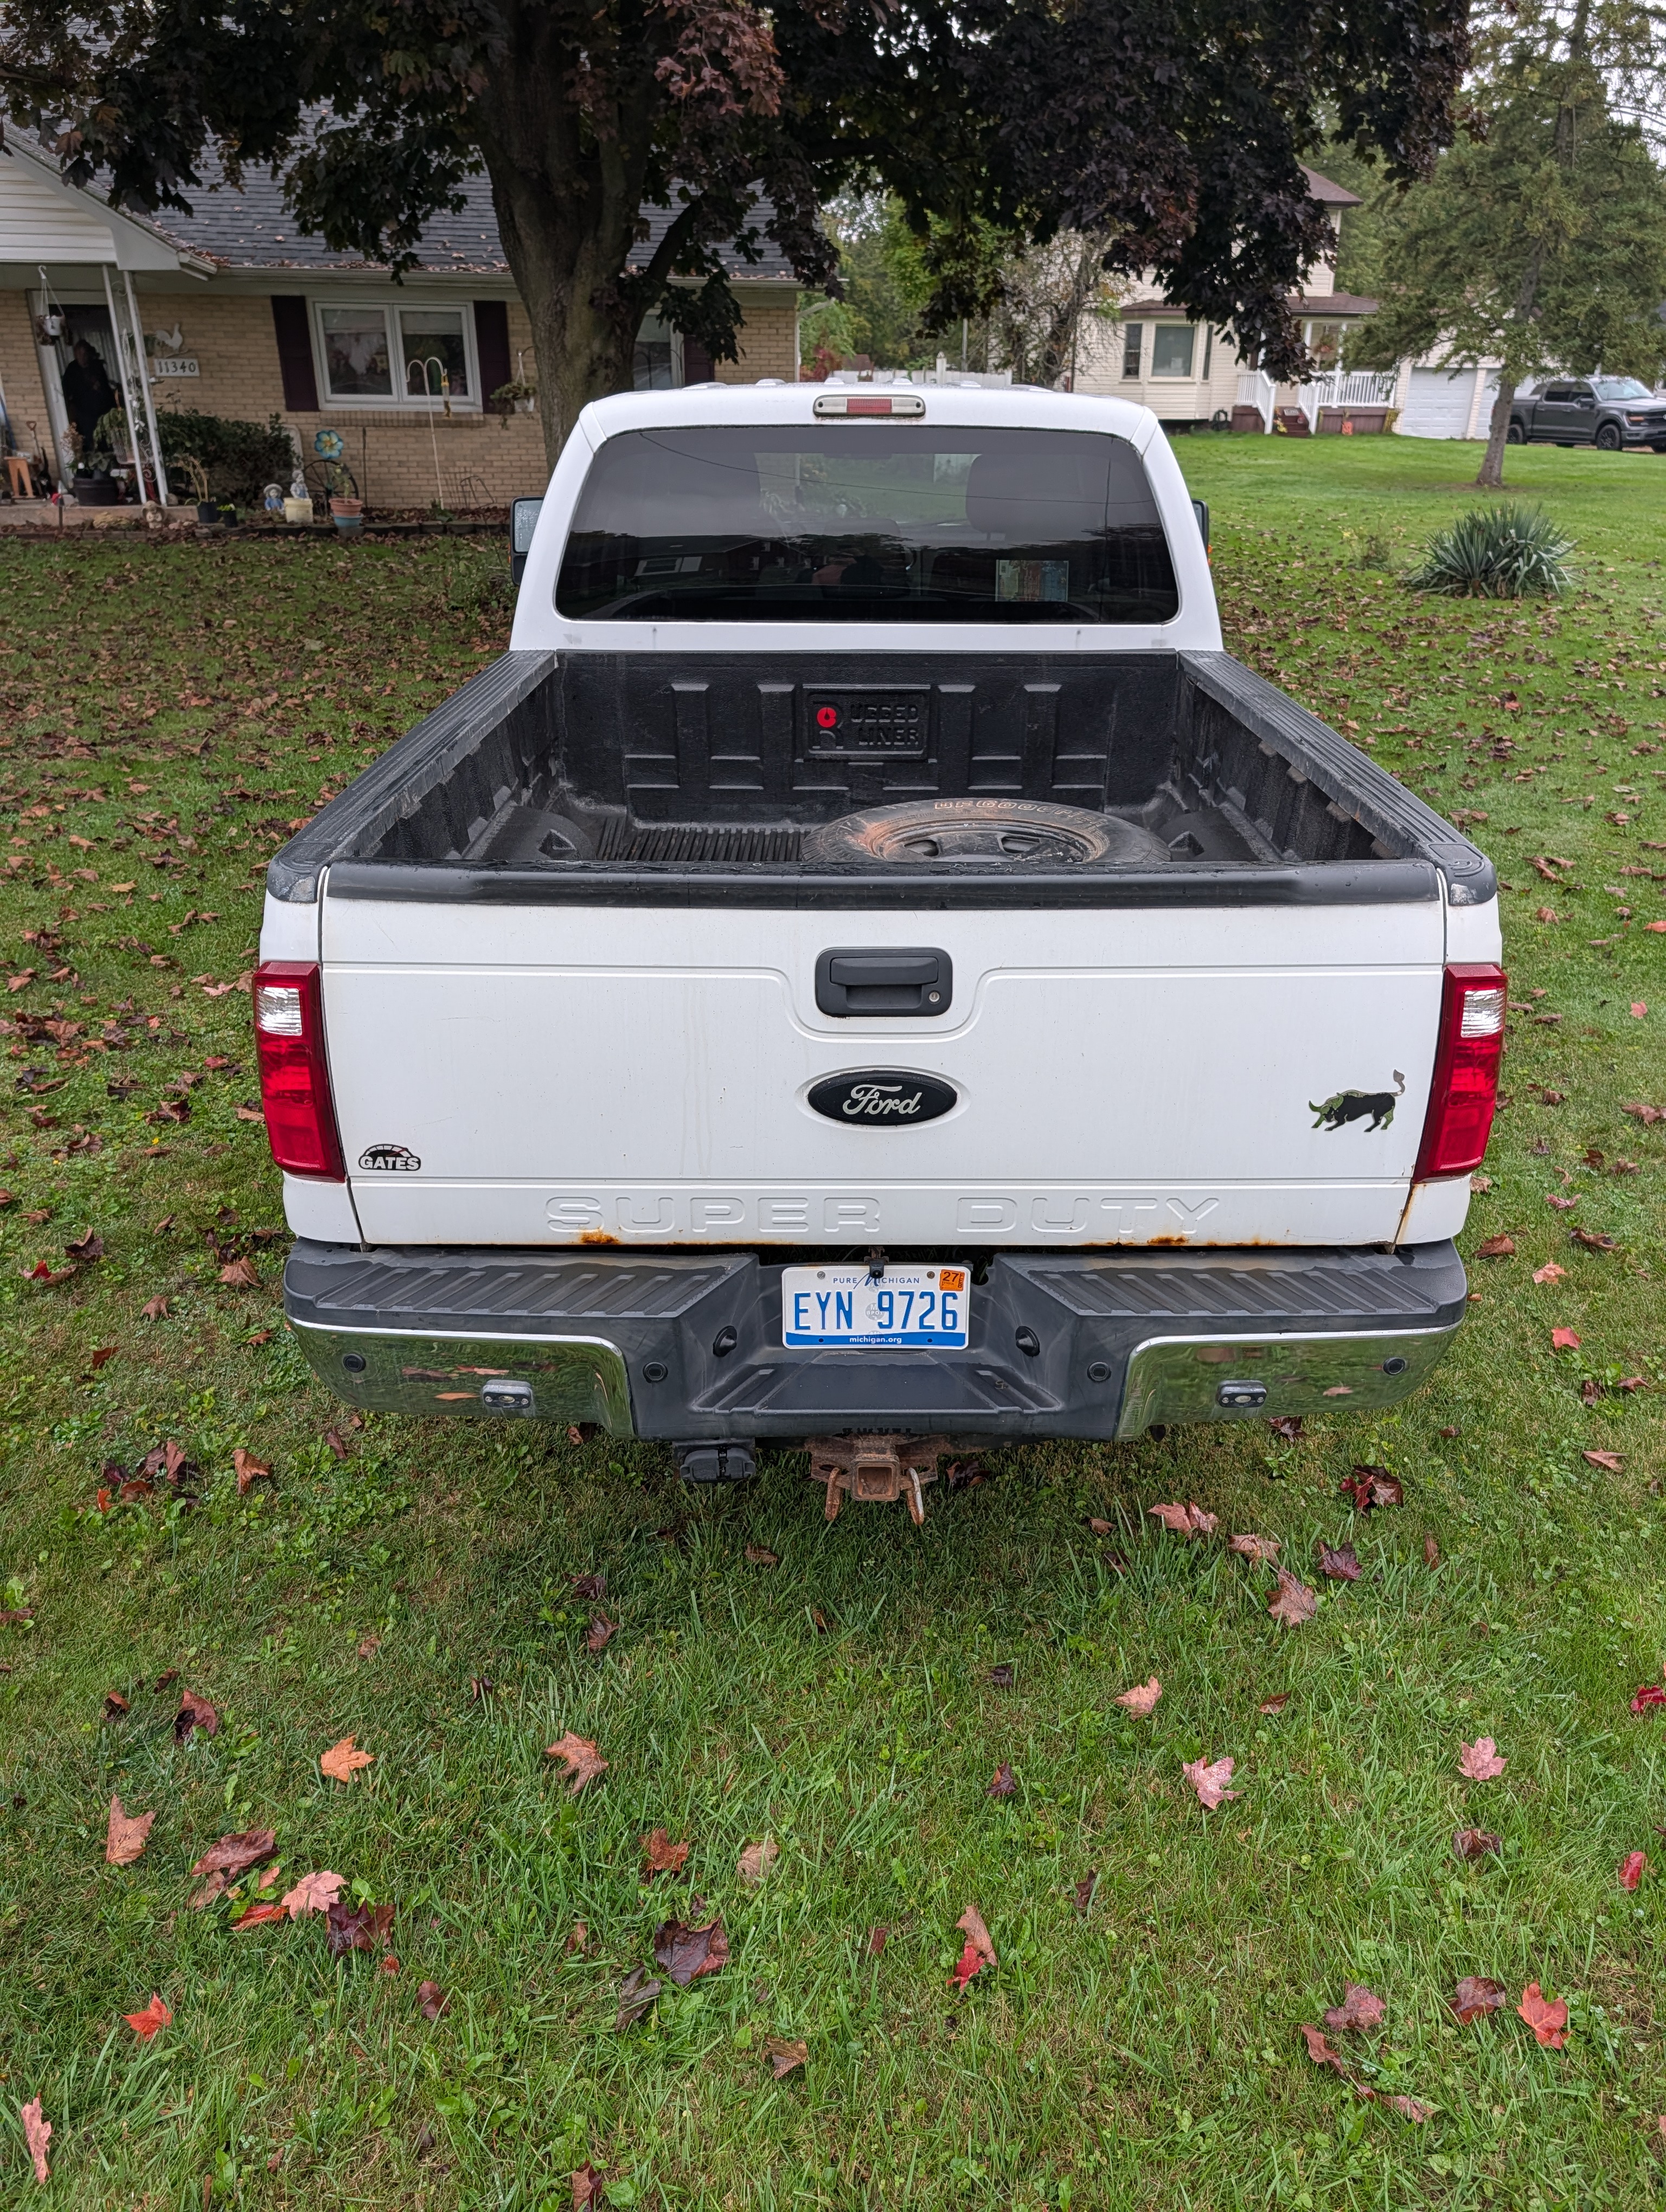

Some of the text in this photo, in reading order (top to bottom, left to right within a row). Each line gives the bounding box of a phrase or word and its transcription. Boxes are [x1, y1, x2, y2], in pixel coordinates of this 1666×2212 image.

[158, 361, 196, 373] 11340
[842, 1084, 922, 1115] Ford
[360, 1156, 419, 1170] GATES
[546, 1197, 1220, 1233] SUPER DUTY
[943, 1271, 959, 1282] 27
[794, 1290, 958, 1330] EYN 9726
